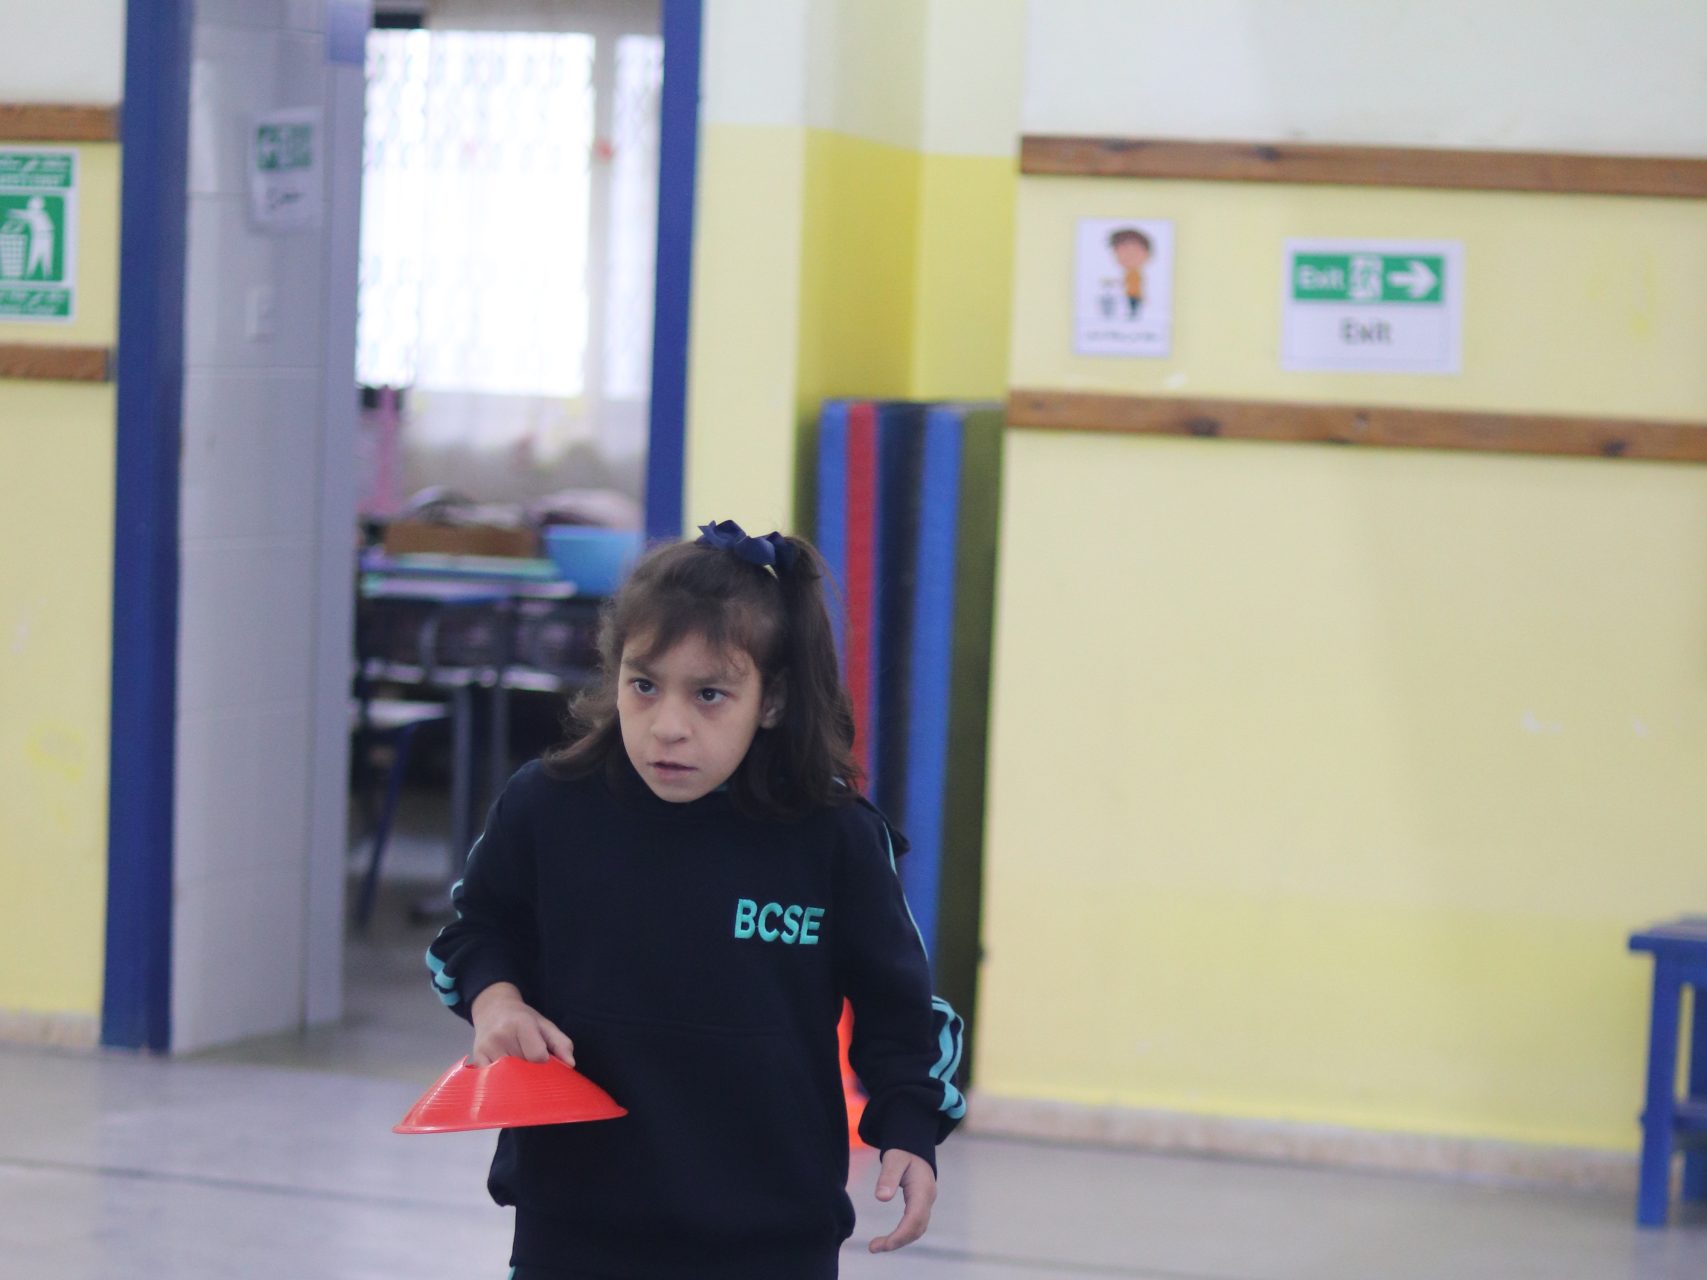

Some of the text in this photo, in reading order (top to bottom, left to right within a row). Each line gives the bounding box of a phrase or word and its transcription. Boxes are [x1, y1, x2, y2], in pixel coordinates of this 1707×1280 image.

[1299, 264, 1345, 290] Exit
[1342, 317, 1391, 343] Exit
[735, 898, 825, 945] BCSE
